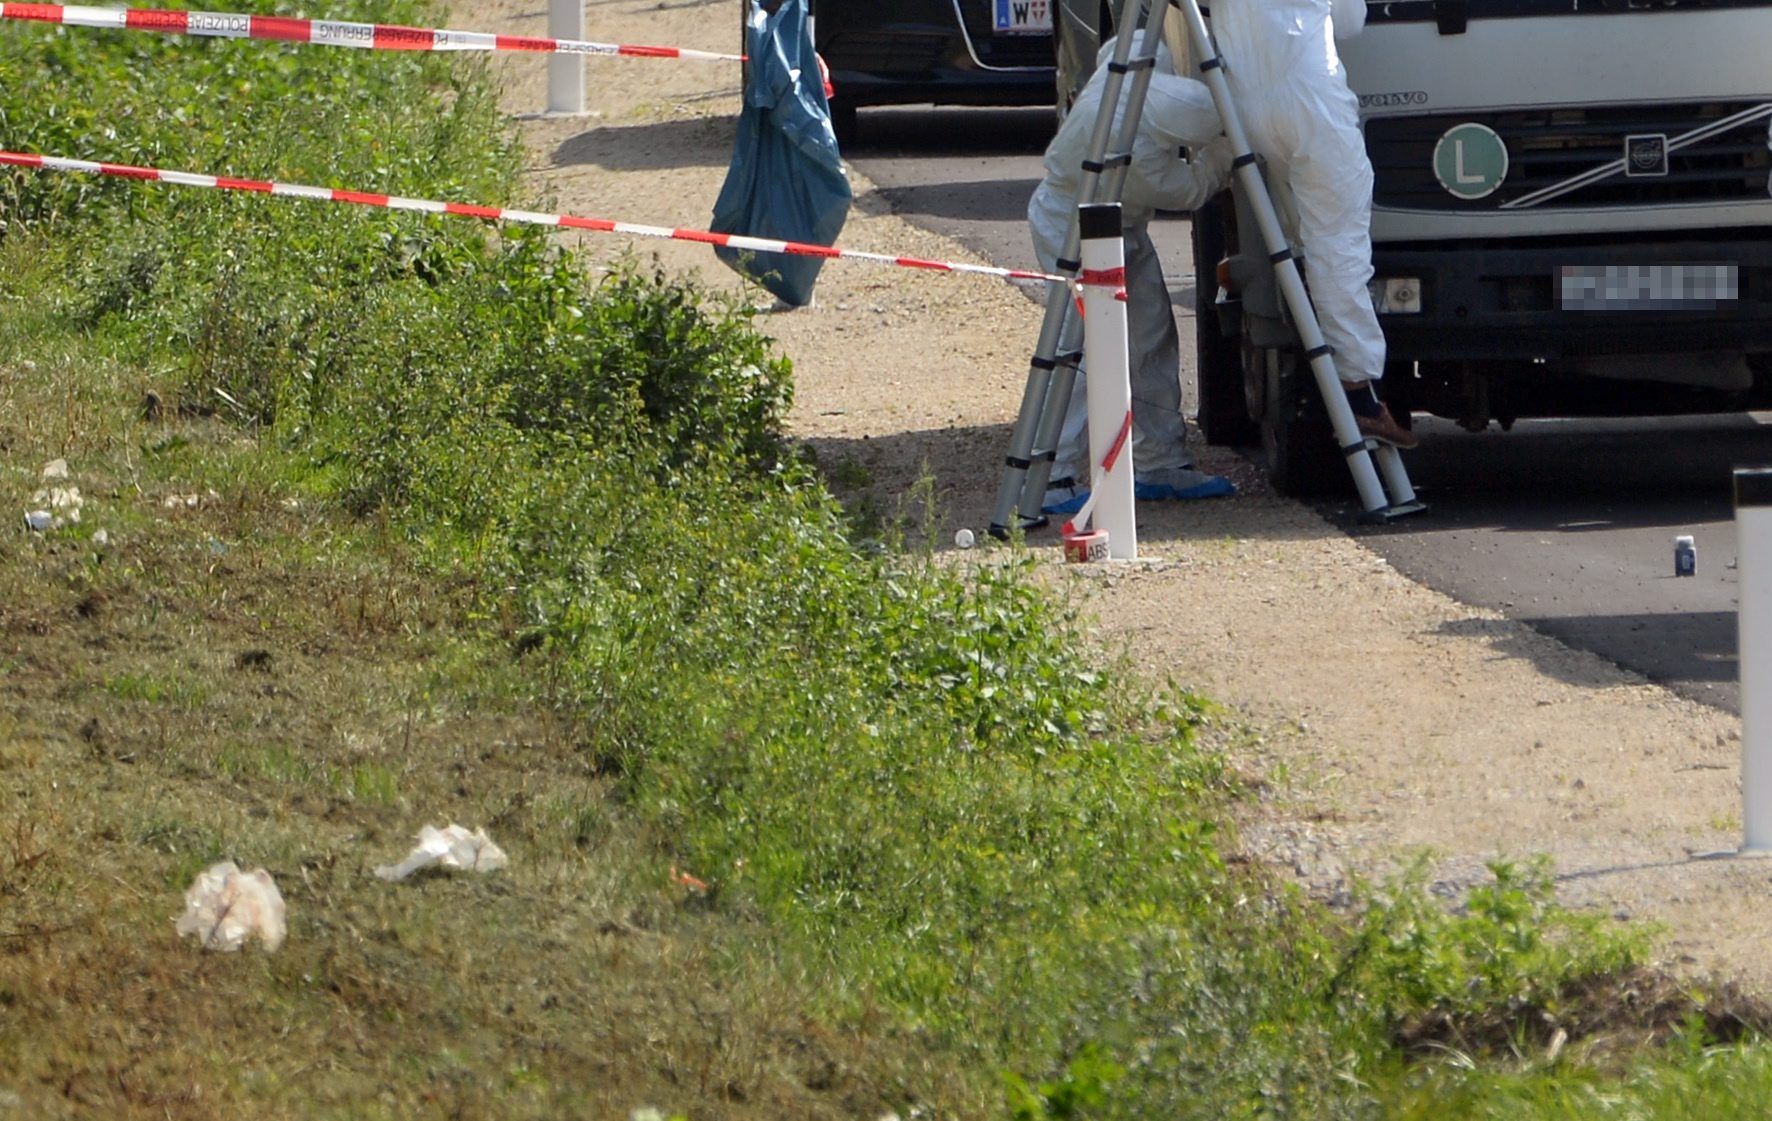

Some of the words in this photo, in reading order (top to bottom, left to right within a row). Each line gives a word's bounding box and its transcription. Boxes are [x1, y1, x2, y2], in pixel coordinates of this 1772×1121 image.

[1013, 2, 1029, 24] W
[1358, 91, 1428, 108] VOLVO
[1455, 140, 1485, 184] L
